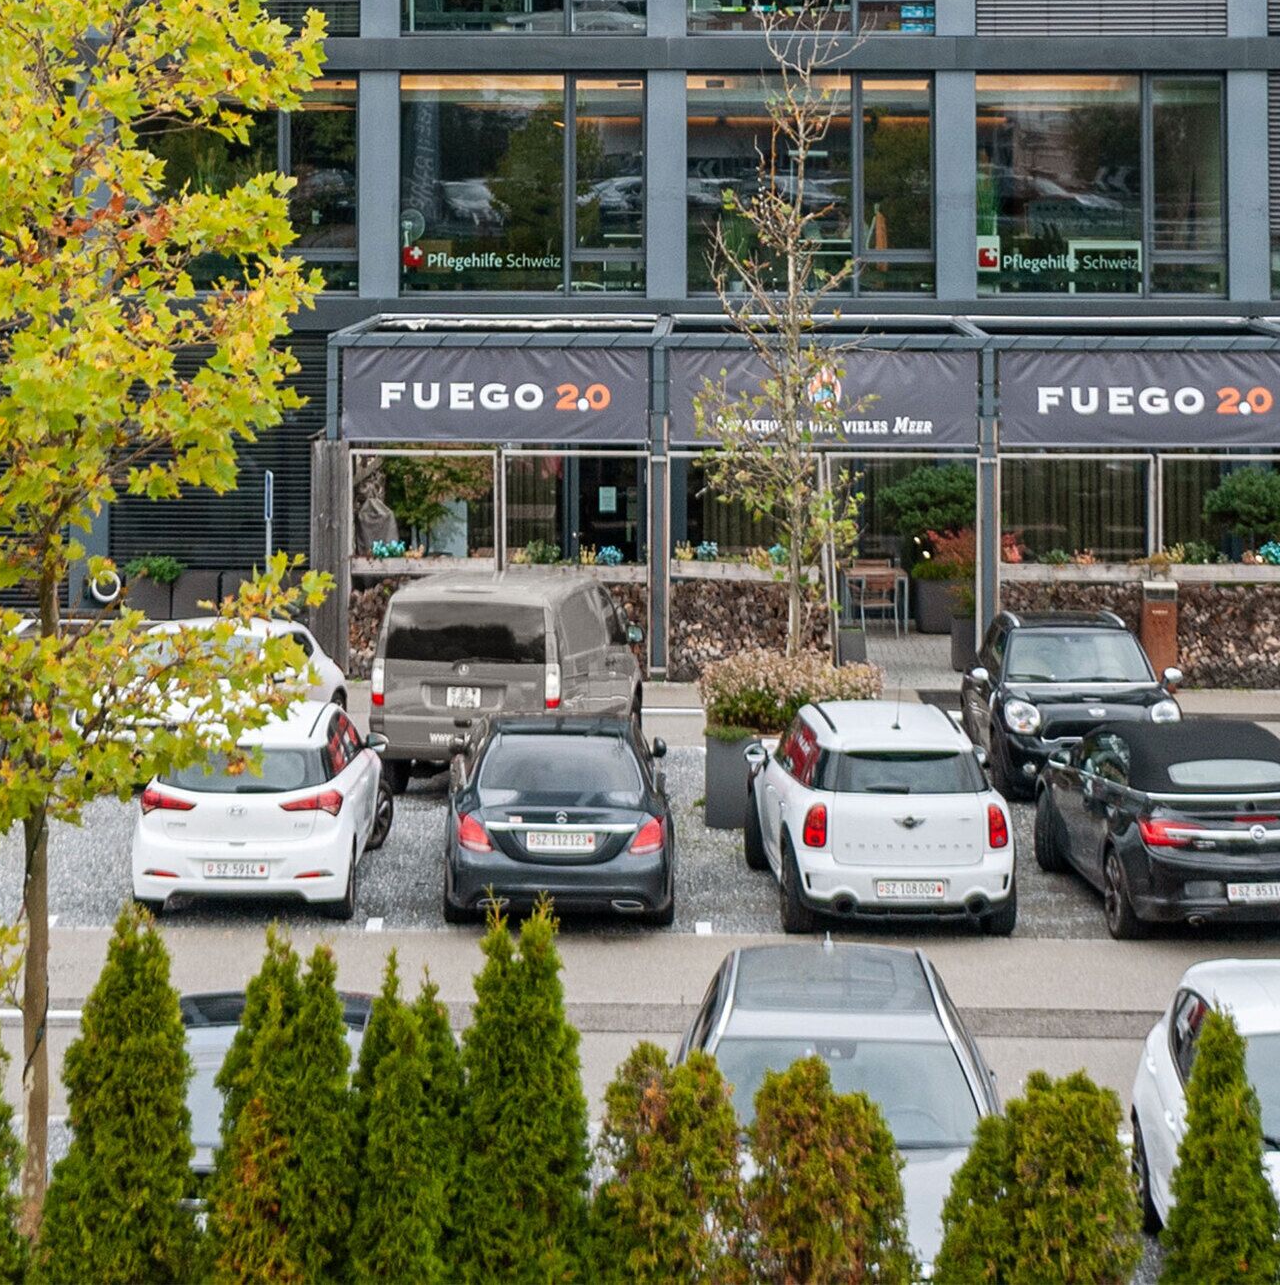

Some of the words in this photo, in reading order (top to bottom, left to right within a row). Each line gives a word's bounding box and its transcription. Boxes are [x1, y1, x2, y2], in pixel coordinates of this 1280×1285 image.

[427, 252, 503, 271] Pflegehilfe
[506, 253, 561, 268] Schweiz
[1003, 254, 1079, 273] Pflegehilfe
[1083, 254, 1138, 269] Schweiz
[380, 381, 544, 411] FUEGO
[554, 383, 611, 412] 2.0
[1037, 386, 1205, 415] FUEGO
[1216, 386, 1273, 415] 2.0
[842, 420, 888, 434] VIELES
[892, 417, 933, 434] MEER
